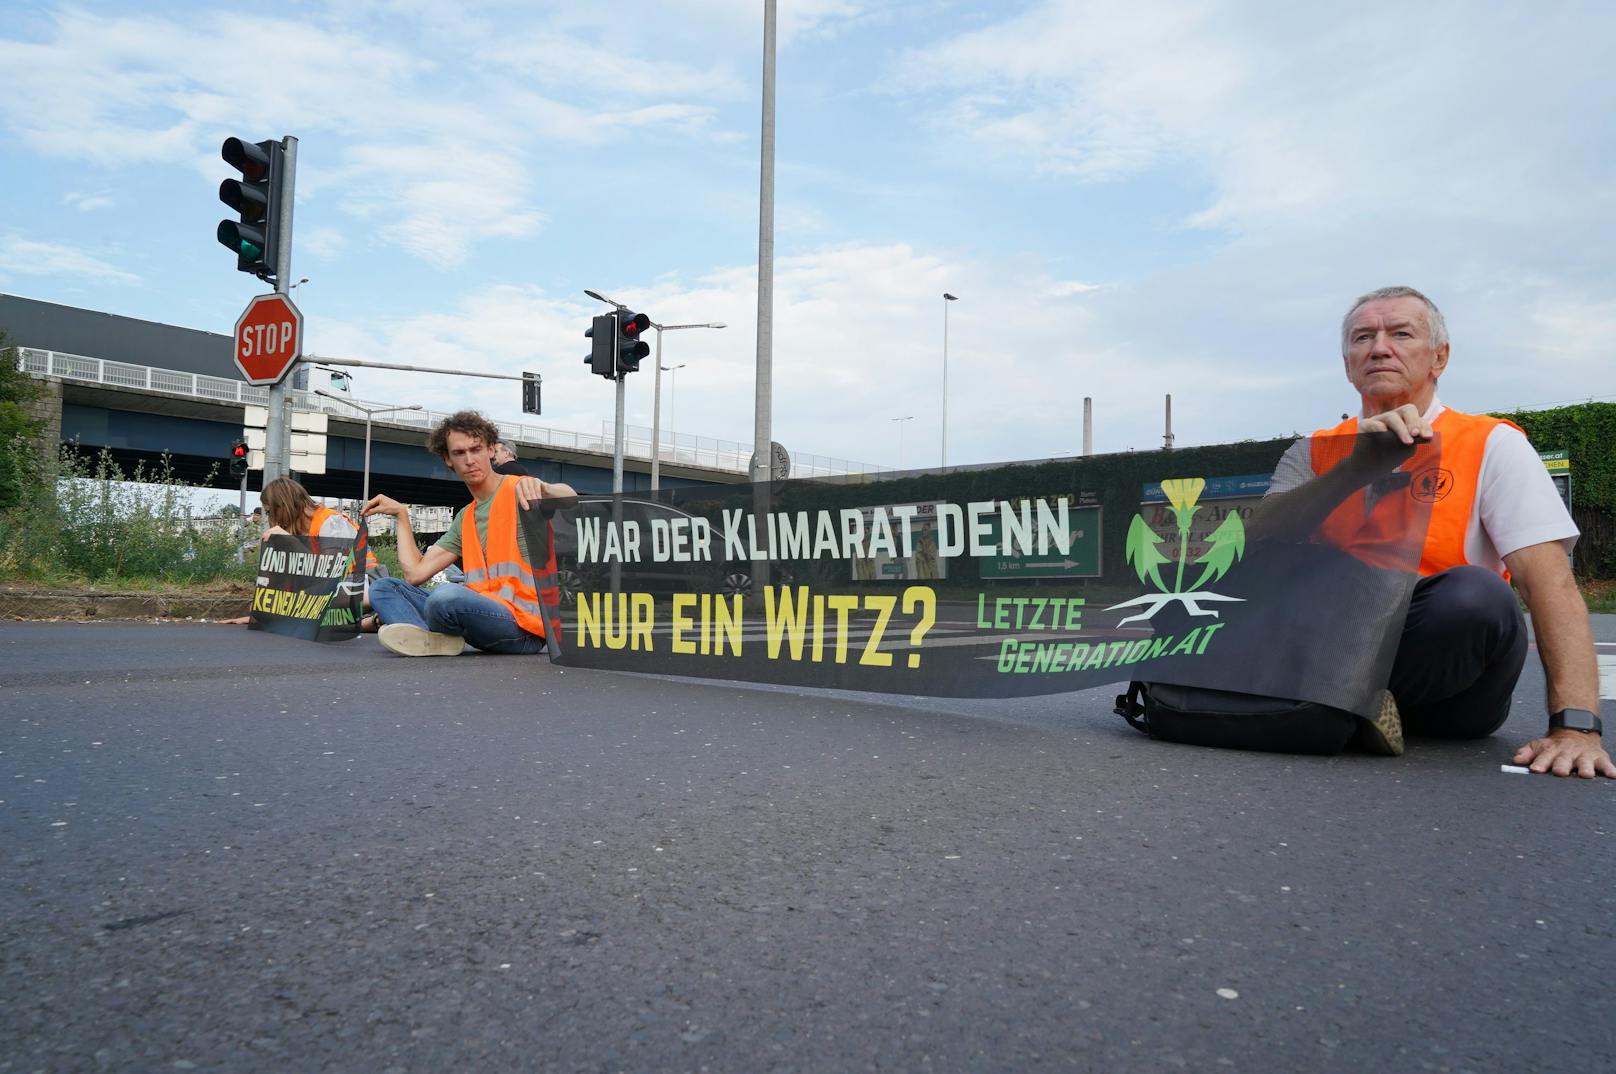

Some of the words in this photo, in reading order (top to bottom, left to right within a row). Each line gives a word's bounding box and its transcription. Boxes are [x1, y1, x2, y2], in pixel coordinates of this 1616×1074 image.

[242, 321, 292, 357] STOP
[576, 517, 641, 563] WAR
[652, 517, 712, 562] DER
[722, 508, 917, 561] KLIMARAT
[936, 498, 1070, 558] DENN
[260, 547, 287, 573] UND
[288, 551, 317, 577] WENN
[315, 554, 334, 578] DIE
[253, 587, 297, 618] KEINEN
[977, 593, 1085, 631] LETZTE
[577, 592, 655, 652] NUR
[672, 593, 743, 657] EIN
[764, 585, 937, 669] WITZ?
[997, 622, 1226, 674] GENERATION.AT
